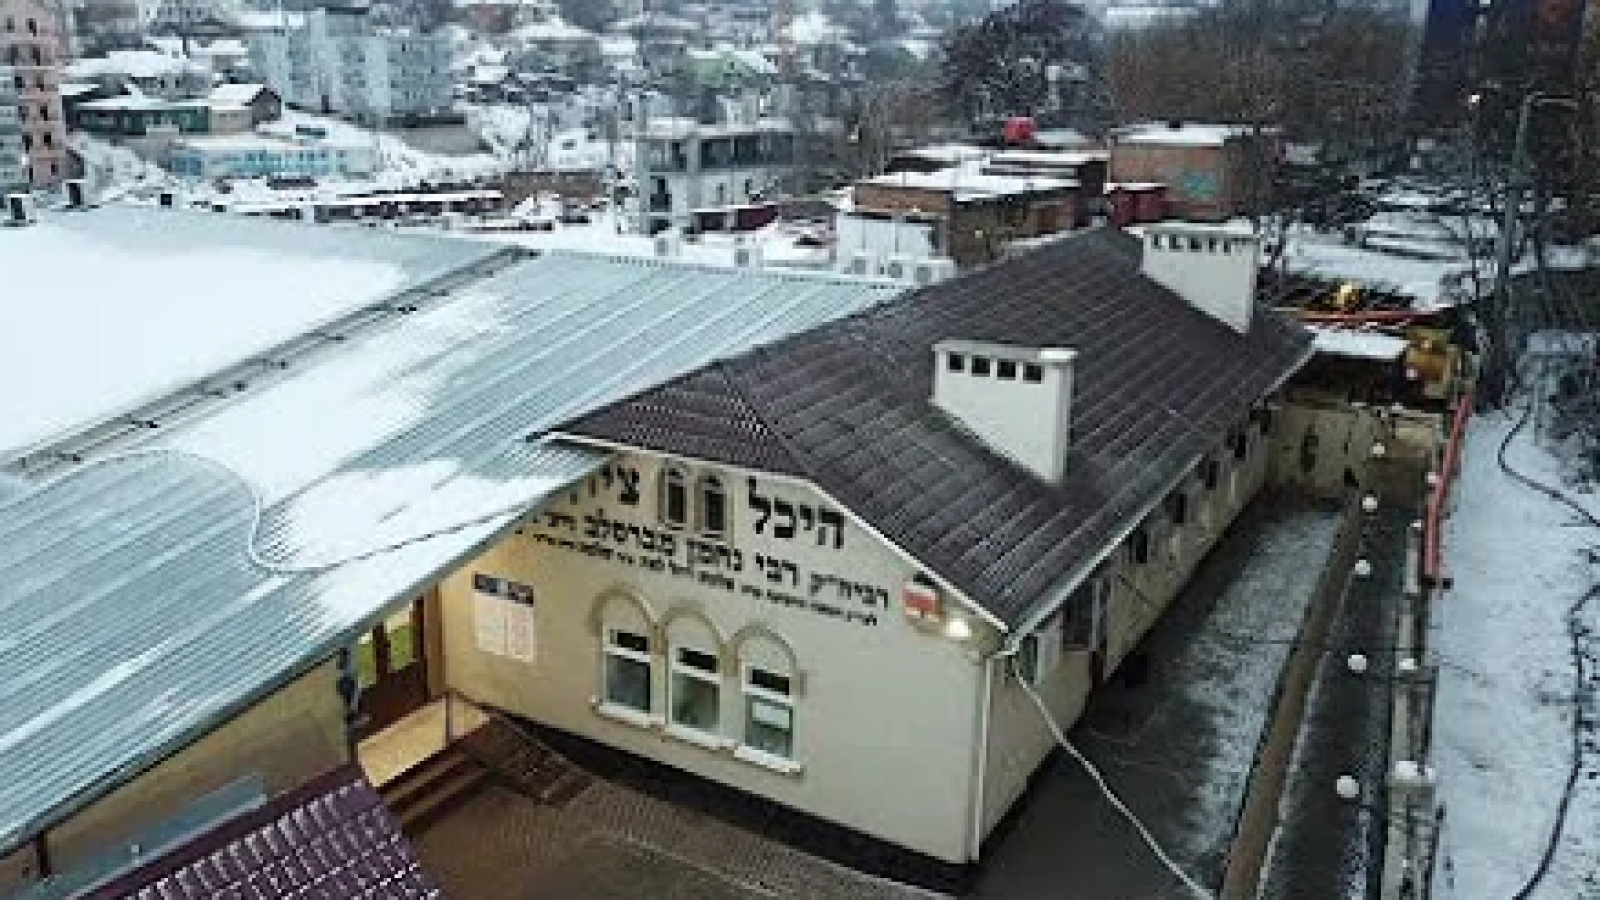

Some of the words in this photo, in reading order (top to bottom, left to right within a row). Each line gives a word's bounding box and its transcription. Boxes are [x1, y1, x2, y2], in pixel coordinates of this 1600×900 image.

[569, 464, 641, 507] ציו
[583, 508, 677, 557] מברסלב
[748, 475, 845, 550] היכל
[686, 536, 743, 573] נחמן
[755, 553, 798, 588] רבי
